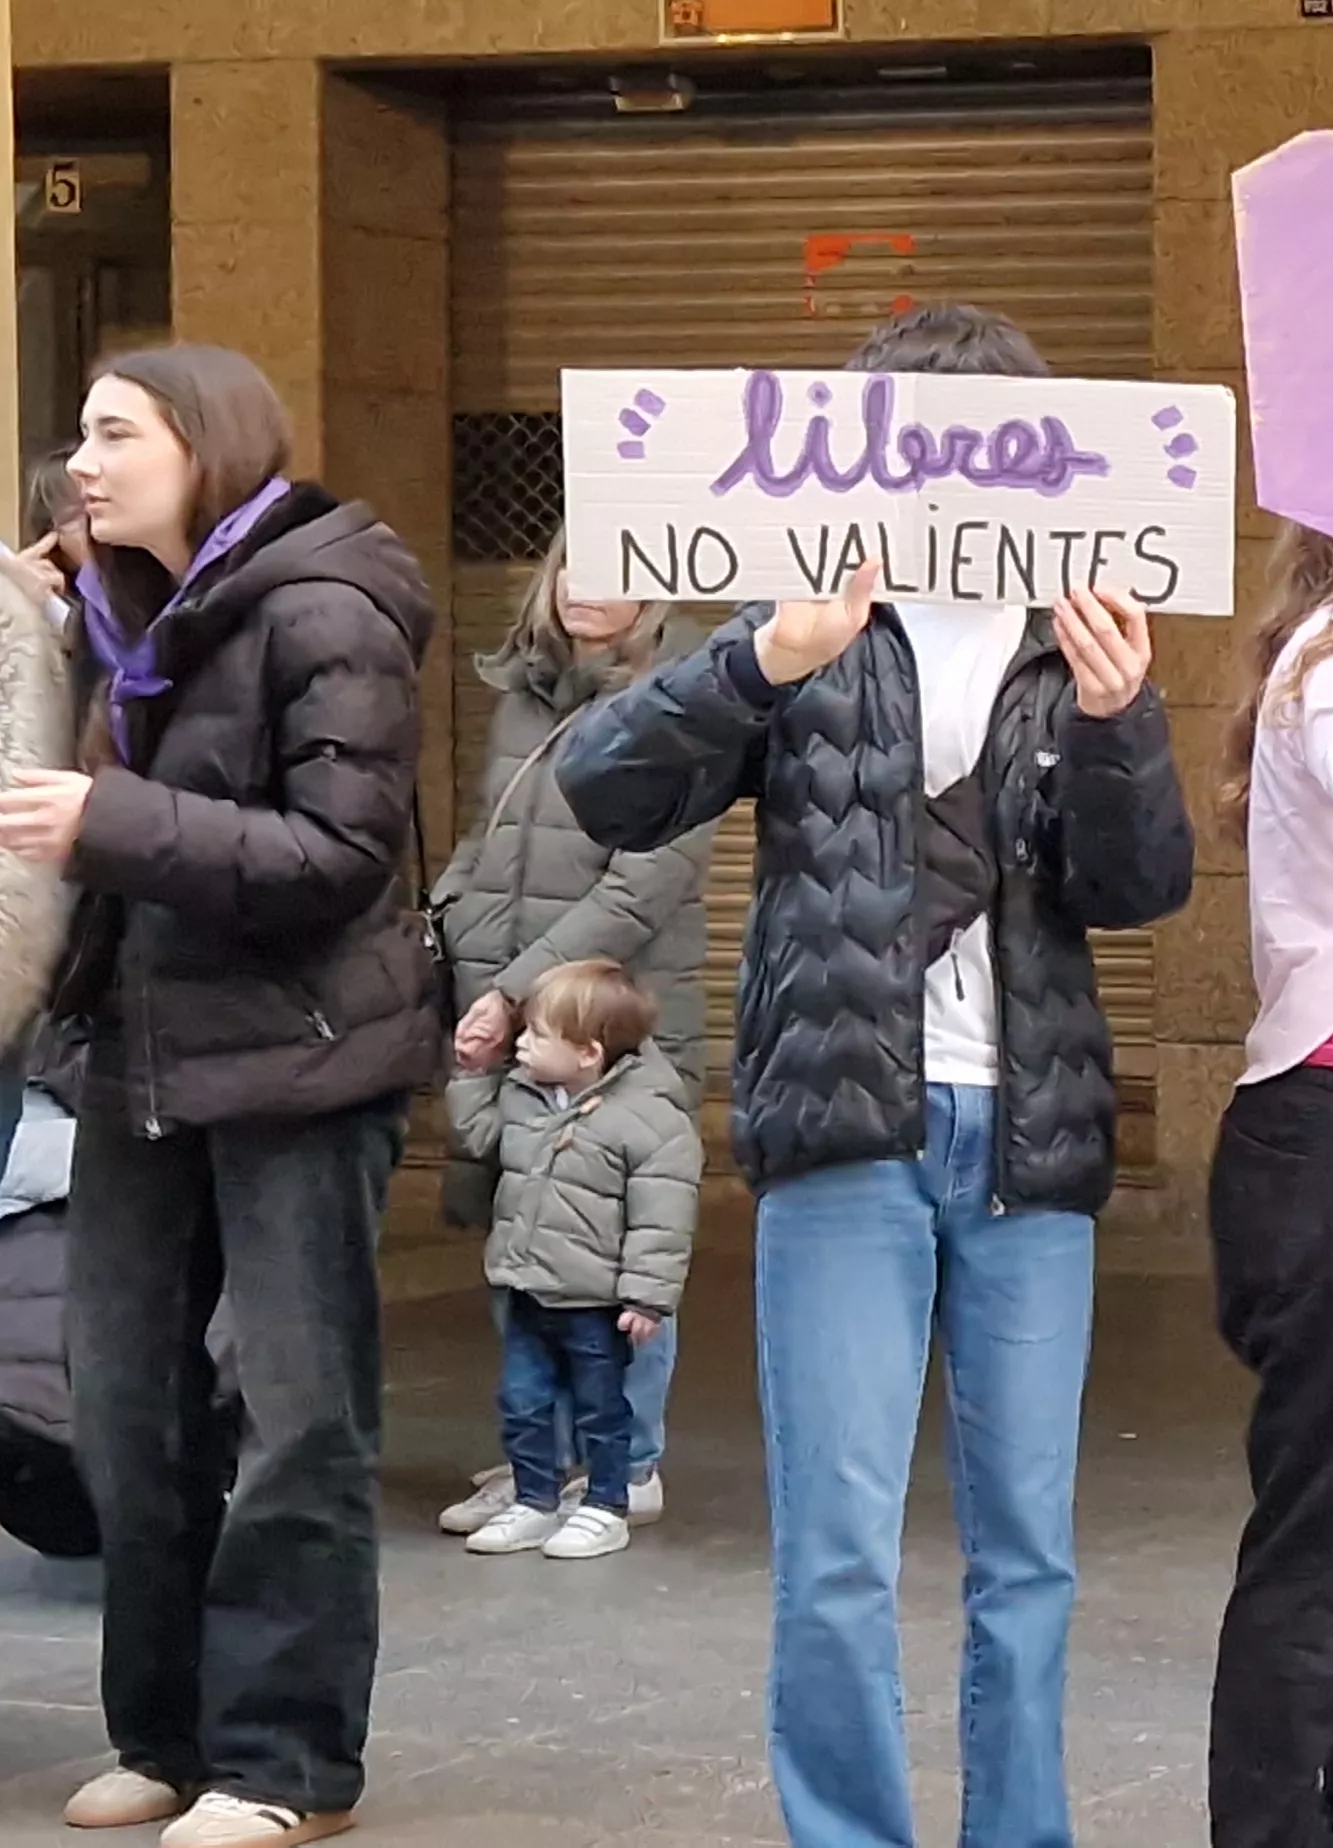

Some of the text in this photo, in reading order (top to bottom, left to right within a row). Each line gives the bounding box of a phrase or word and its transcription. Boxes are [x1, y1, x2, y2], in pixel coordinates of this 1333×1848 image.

[50, 161, 76, 207] 5
[708, 371, 1111, 498] libres
[620, 523, 739, 595] NO
